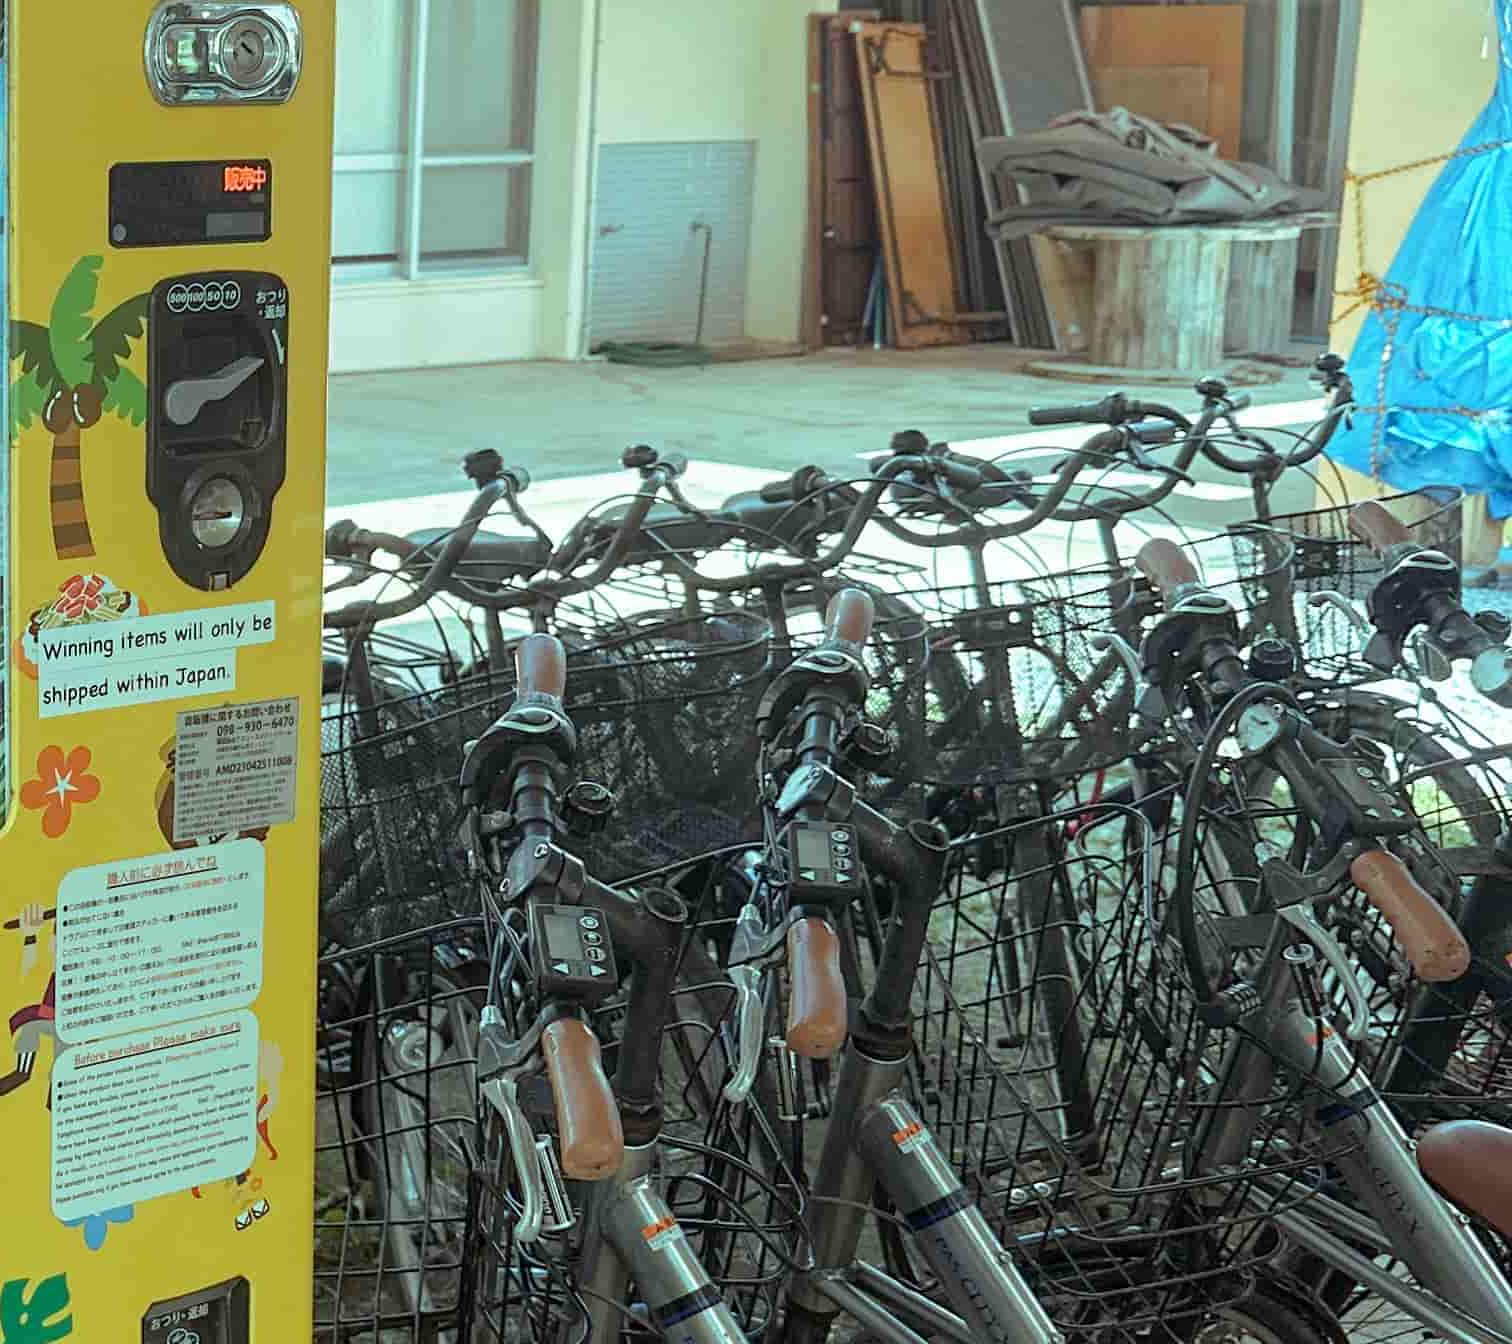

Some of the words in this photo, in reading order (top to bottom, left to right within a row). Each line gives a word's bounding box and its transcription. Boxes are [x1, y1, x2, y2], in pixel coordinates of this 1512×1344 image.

[223, 166, 267, 192] 販売中
[255, 287, 287, 304] おつり
[42, 634, 114, 660] Winning
[120, 626, 168, 649] items
[174, 621, 204, 643] will
[210, 617, 246, 639] only
[252, 614, 273, 632] be
[42, 678, 109, 706] shipped
[116, 671, 169, 694] within
[175, 664, 231, 690] Japan.
